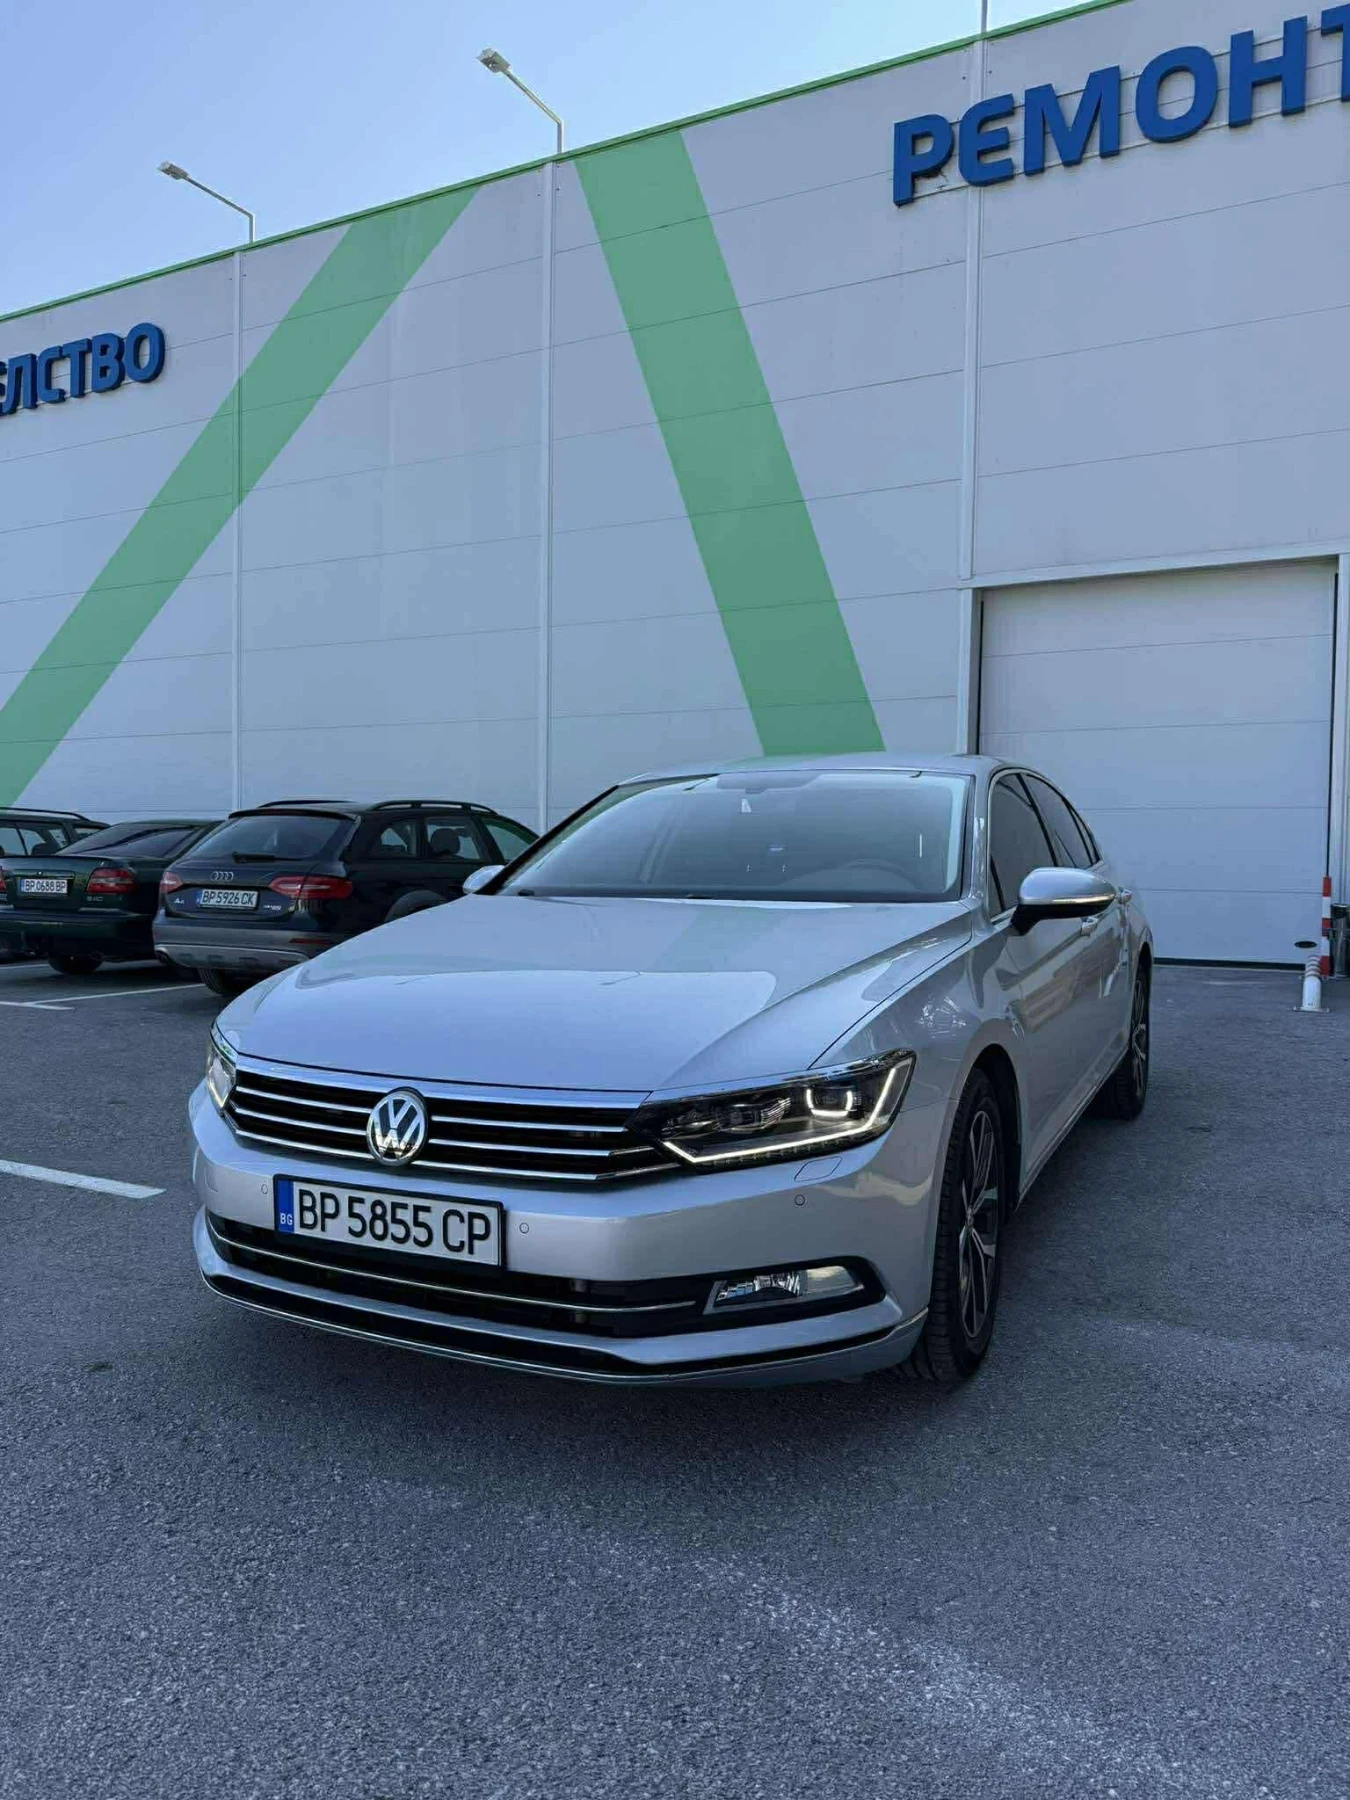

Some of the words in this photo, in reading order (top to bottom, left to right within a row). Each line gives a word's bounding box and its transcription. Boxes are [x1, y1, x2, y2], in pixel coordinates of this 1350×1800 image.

[0, 322, 166, 416] ЛСТВО
[25, 880, 35, 891] BP
[202, 890, 216, 904] BP
[216, 891, 239, 905] 5926
[240, 892, 255, 906] CK
[280, 1212, 293, 1226] BG
[299, 1188, 340, 1232] BP
[347, 1195, 433, 1248] 5855
[442, 1208, 491, 1256] CP
